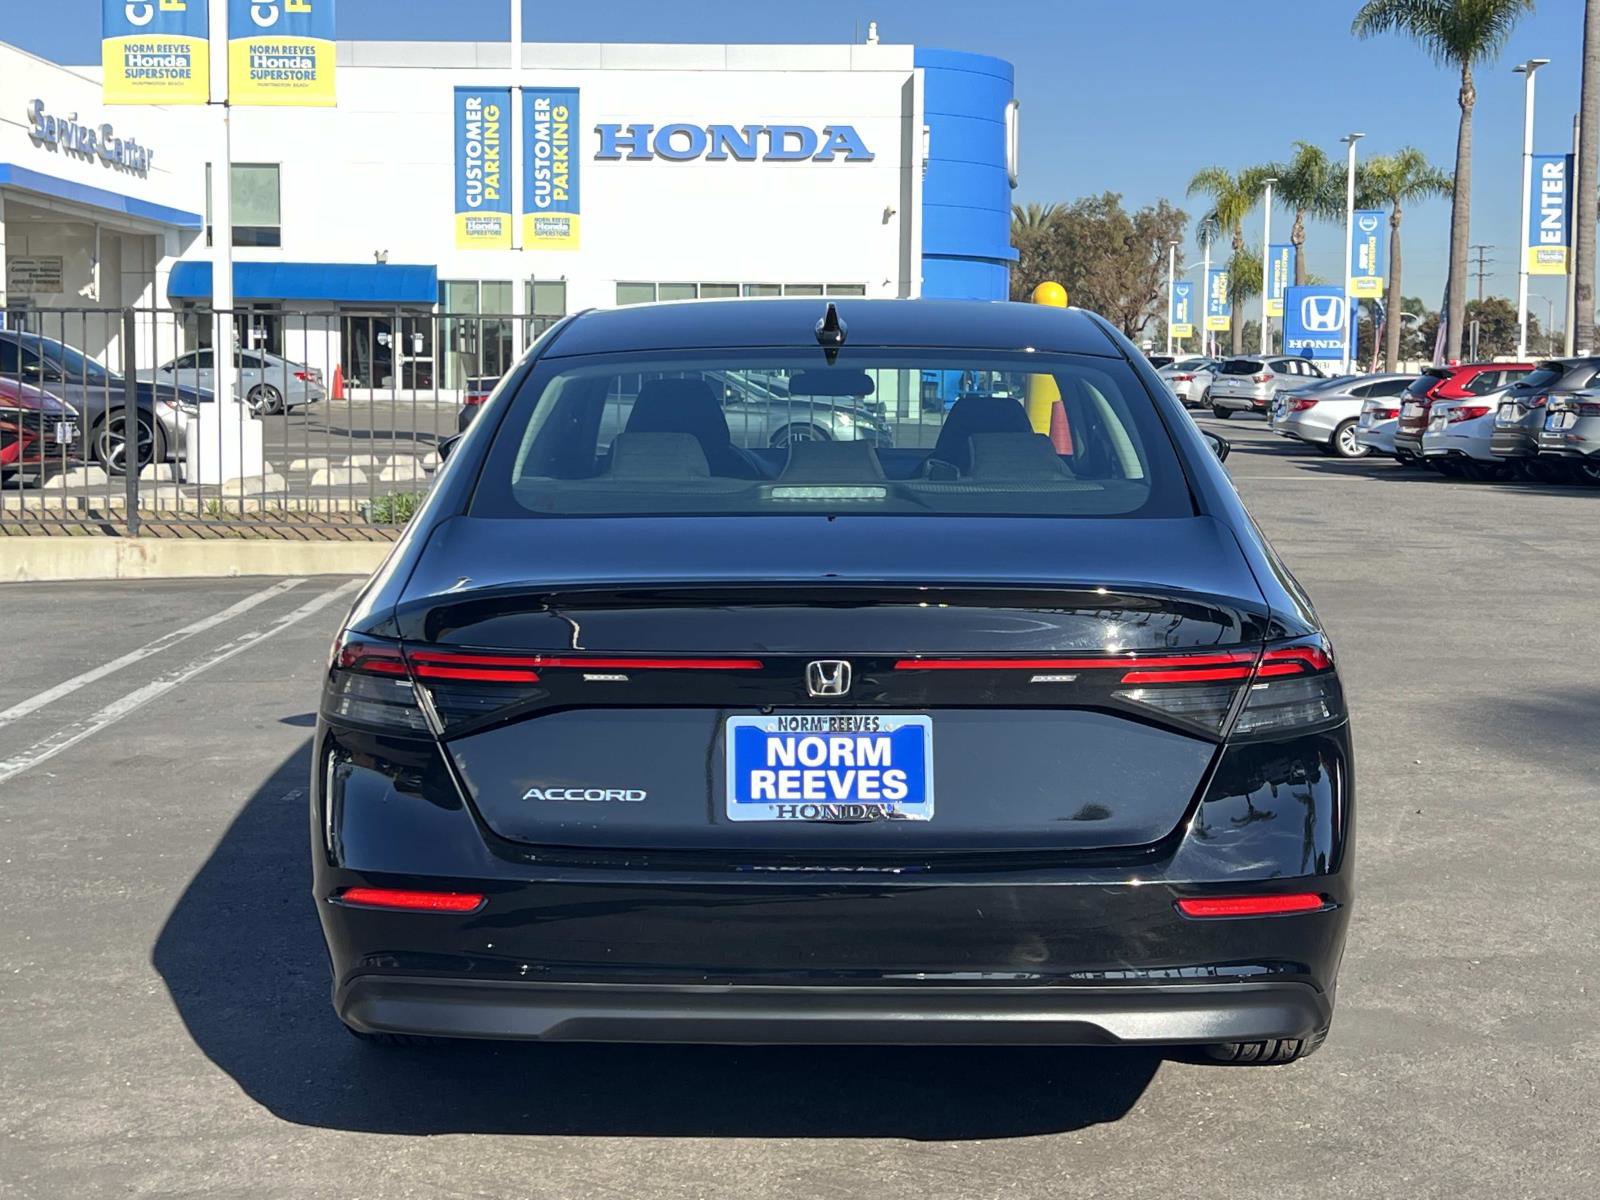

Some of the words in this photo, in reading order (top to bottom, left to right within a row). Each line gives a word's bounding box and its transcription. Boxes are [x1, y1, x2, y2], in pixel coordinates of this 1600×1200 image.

[124, 44, 155, 54] NORM
[157, 44, 190, 54] REEVES
[128, 54, 188, 67] Honda
[249, 45, 280, 55] NORM
[282, 45, 316, 55] REEVES
[253, 55, 312, 68] Honda
[125, 68, 191, 79] SUPERSTORE
[250, 70, 317, 81] SUPERSTORE
[27, 98, 97, 160] Service
[97, 123, 154, 175] Center
[593, 123, 876, 162] HONDA
[465, 97, 482, 208] CUSTOMER
[484, 105, 500, 200] PARKING
[535, 98, 551, 209] CUSTOMER
[552, 106, 569, 201] PARKING
[1540, 161, 1564, 244] ENTER
[778, 717, 822, 732] NORM
[828, 716, 880, 732] REEVES
[767, 737, 892, 767] NORM
[522, 788, 647, 802] ACCORD
[751, 769, 908, 800] REEVES
[776, 804, 888, 820] HONDA
